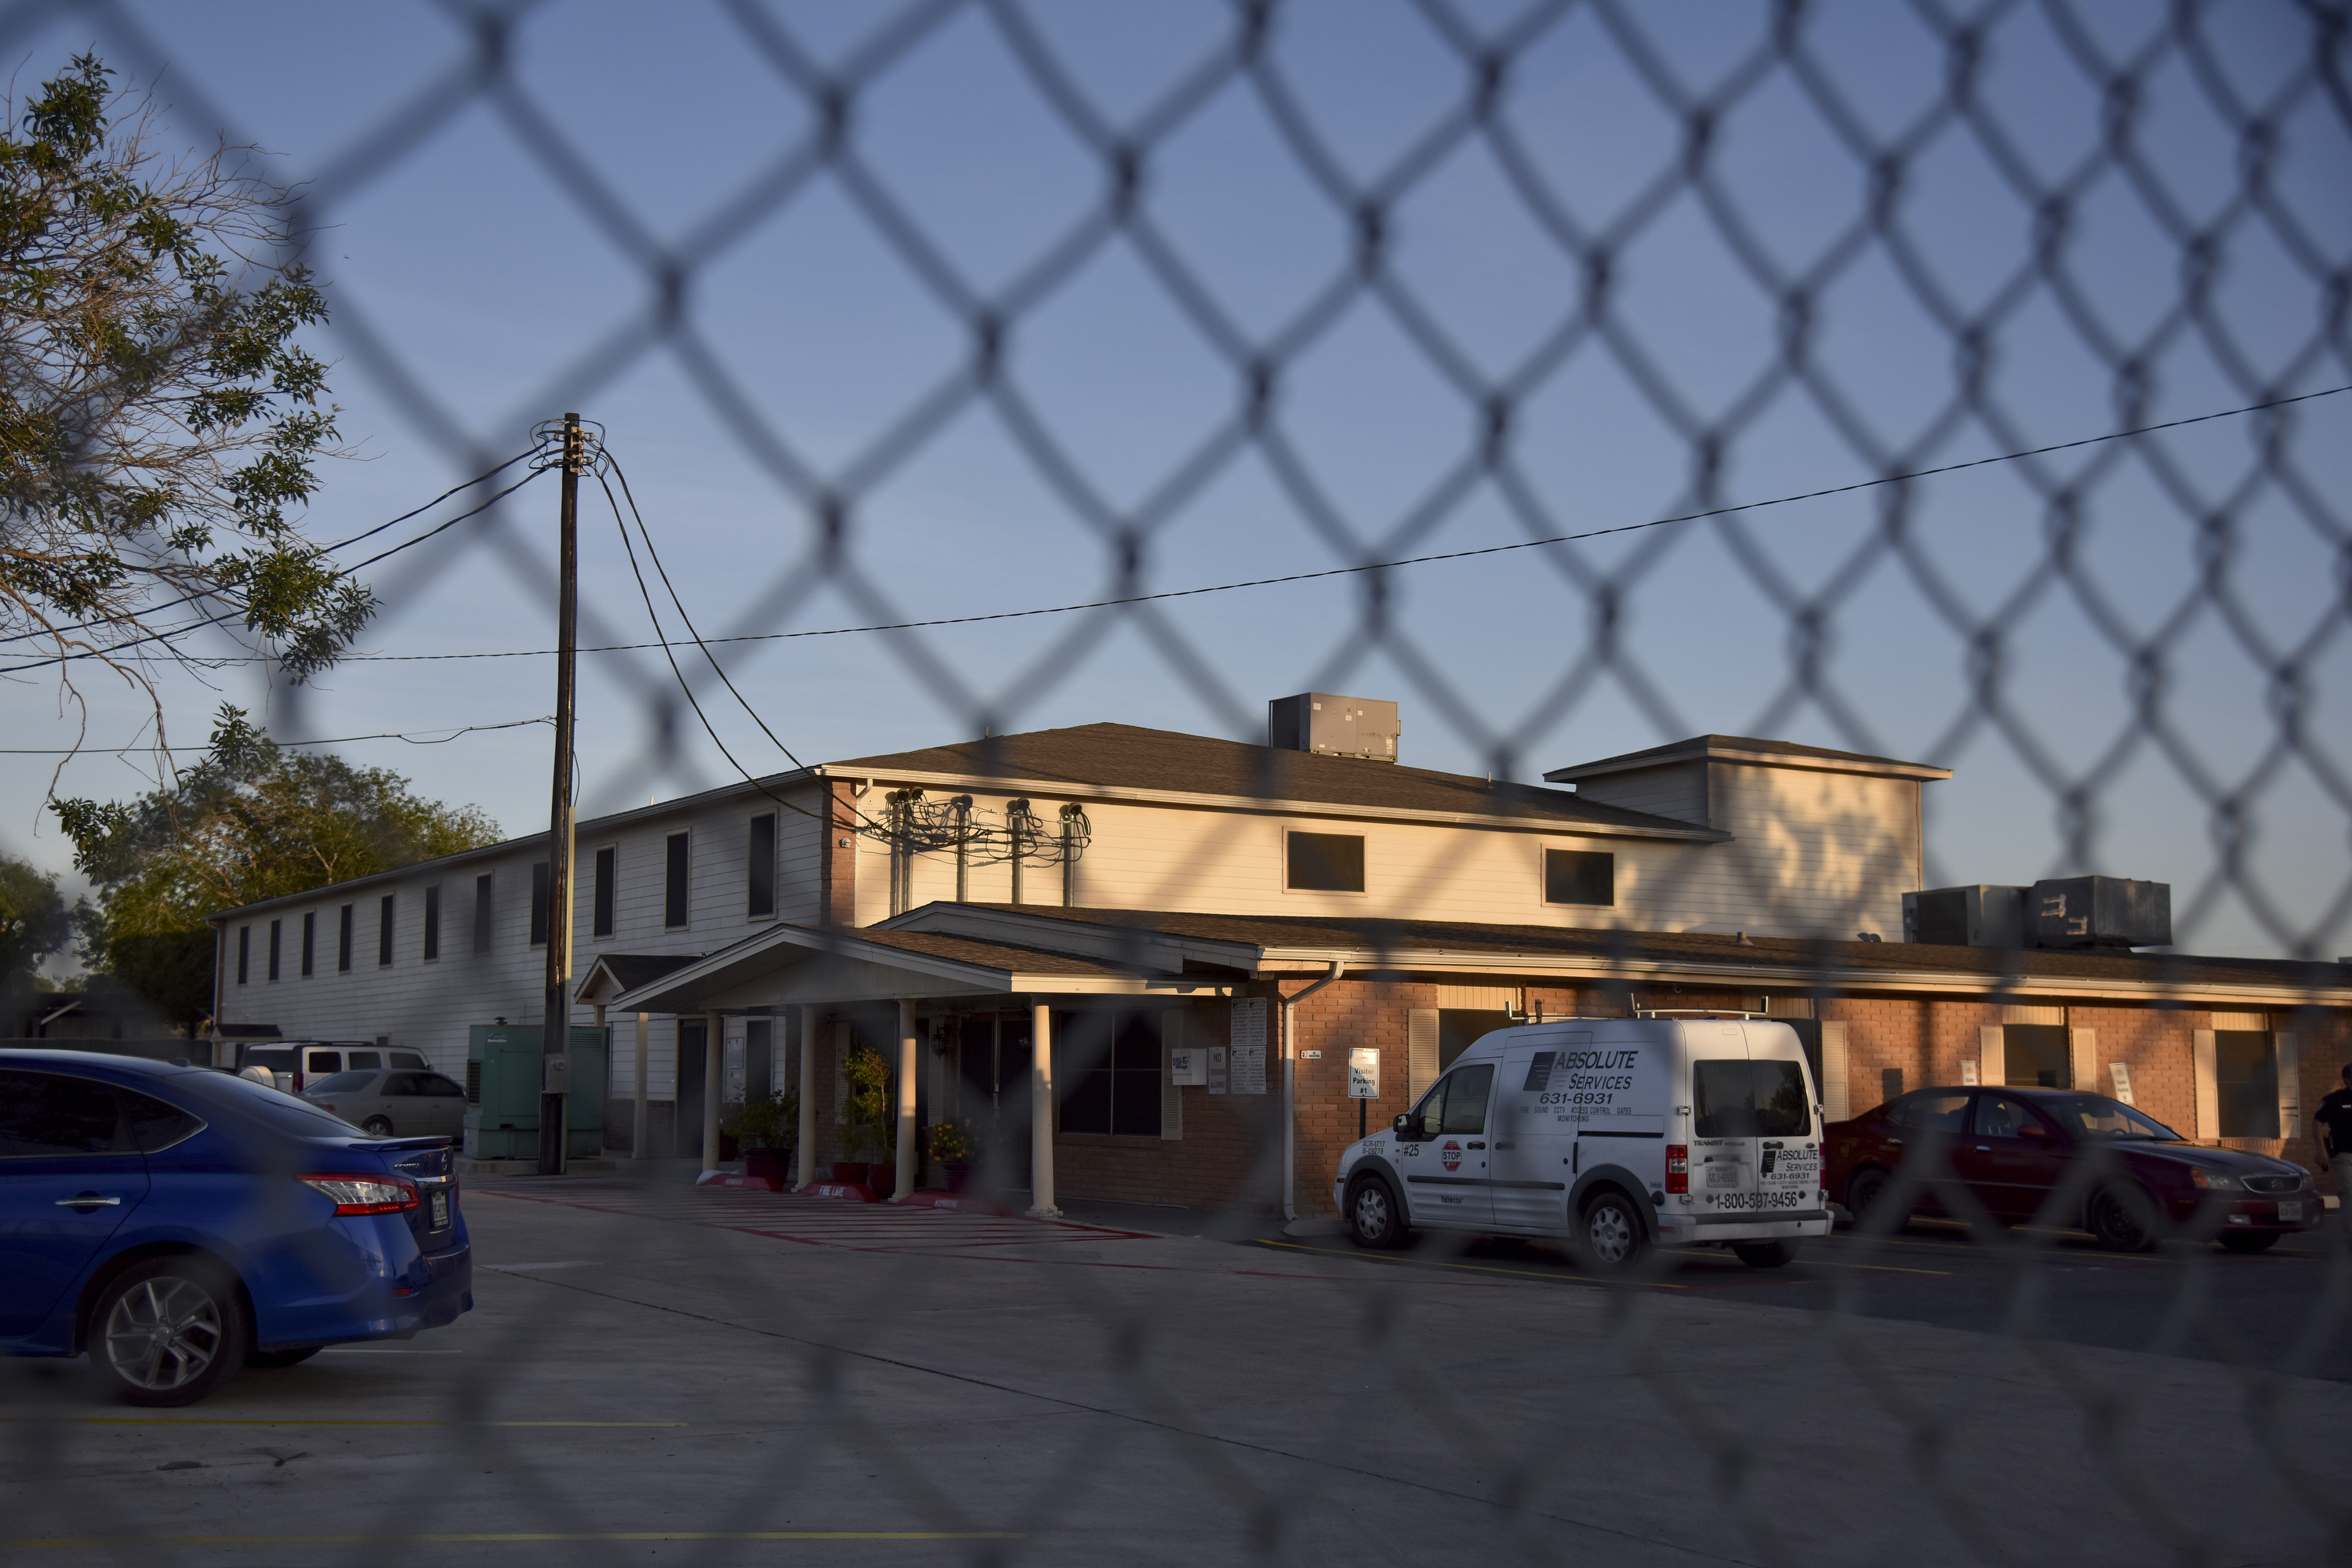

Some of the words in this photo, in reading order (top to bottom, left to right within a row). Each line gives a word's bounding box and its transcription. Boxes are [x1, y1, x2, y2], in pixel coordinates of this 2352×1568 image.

[1214, 1053, 1222, 1063] NO
[1554, 1051, 1639, 1069] ABSOLUTE
[1352, 1077, 1375, 1086] Parking
[1569, 1073, 1632, 1090] SERVICES
[1540, 1093, 1613, 1104] 631-6931
[1403, 1144, 1419, 1156] #25
[1777, 1150, 1818, 1160] ABSOLUTE
[1786, 1162, 1817, 1171] SERVICES
[1715, 1192, 1798, 1209] 1-800-597-9456
